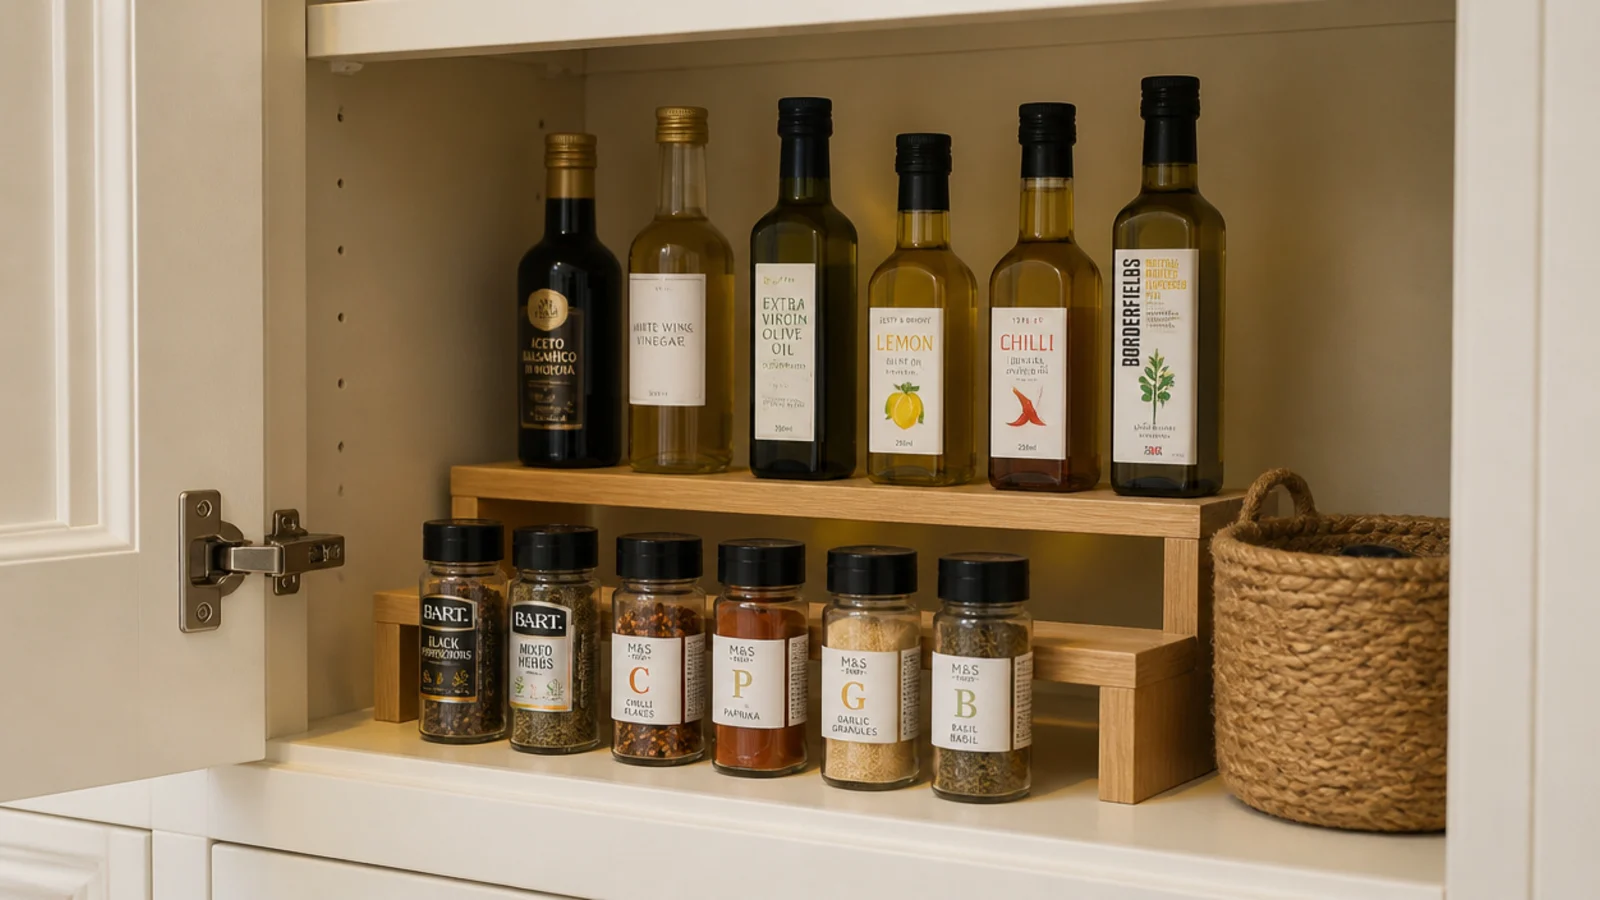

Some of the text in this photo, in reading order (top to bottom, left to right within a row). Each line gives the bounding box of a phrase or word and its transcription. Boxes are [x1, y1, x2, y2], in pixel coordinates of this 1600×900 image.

[763, 297, 805, 311] EXTRA
[762, 328, 802, 341] OLIVE
[876, 334, 934, 352] LEMON
[1000, 333, 1054, 352] CHILLI
[771, 343, 794, 356] OIL
[515, 611, 563, 630] BART.
[729, 645, 755, 657] M&S
[841, 656, 867, 669] M&S
[629, 666, 650, 695] C
[732, 669, 753, 699] P
[841, 681, 867, 711] G
[954, 688, 977, 719] B
